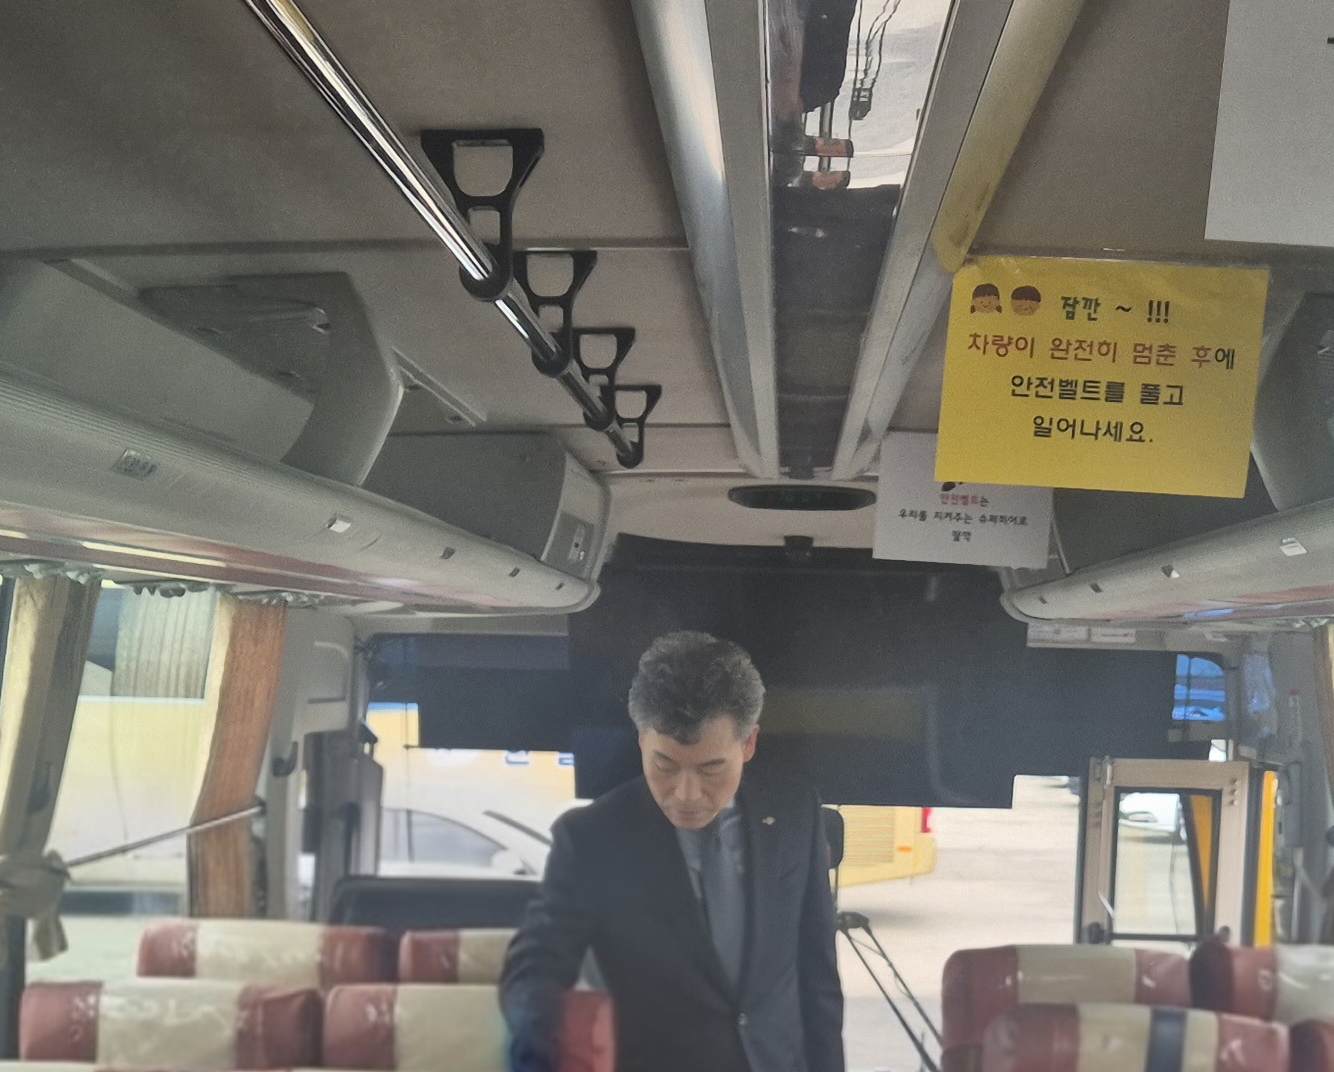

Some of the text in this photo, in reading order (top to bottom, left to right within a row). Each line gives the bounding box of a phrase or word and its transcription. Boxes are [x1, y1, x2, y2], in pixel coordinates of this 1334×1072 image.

[1060, 296, 1101, 322] 잠깐
[1147, 299, 1171, 324] !!!
[968, 332, 1236, 371] 차량이 완전히 멈춘 후에
[1011, 375, 1184, 406] 안전벨트를 풀고
[1033, 415, 1153, 443] 일어나세요.
